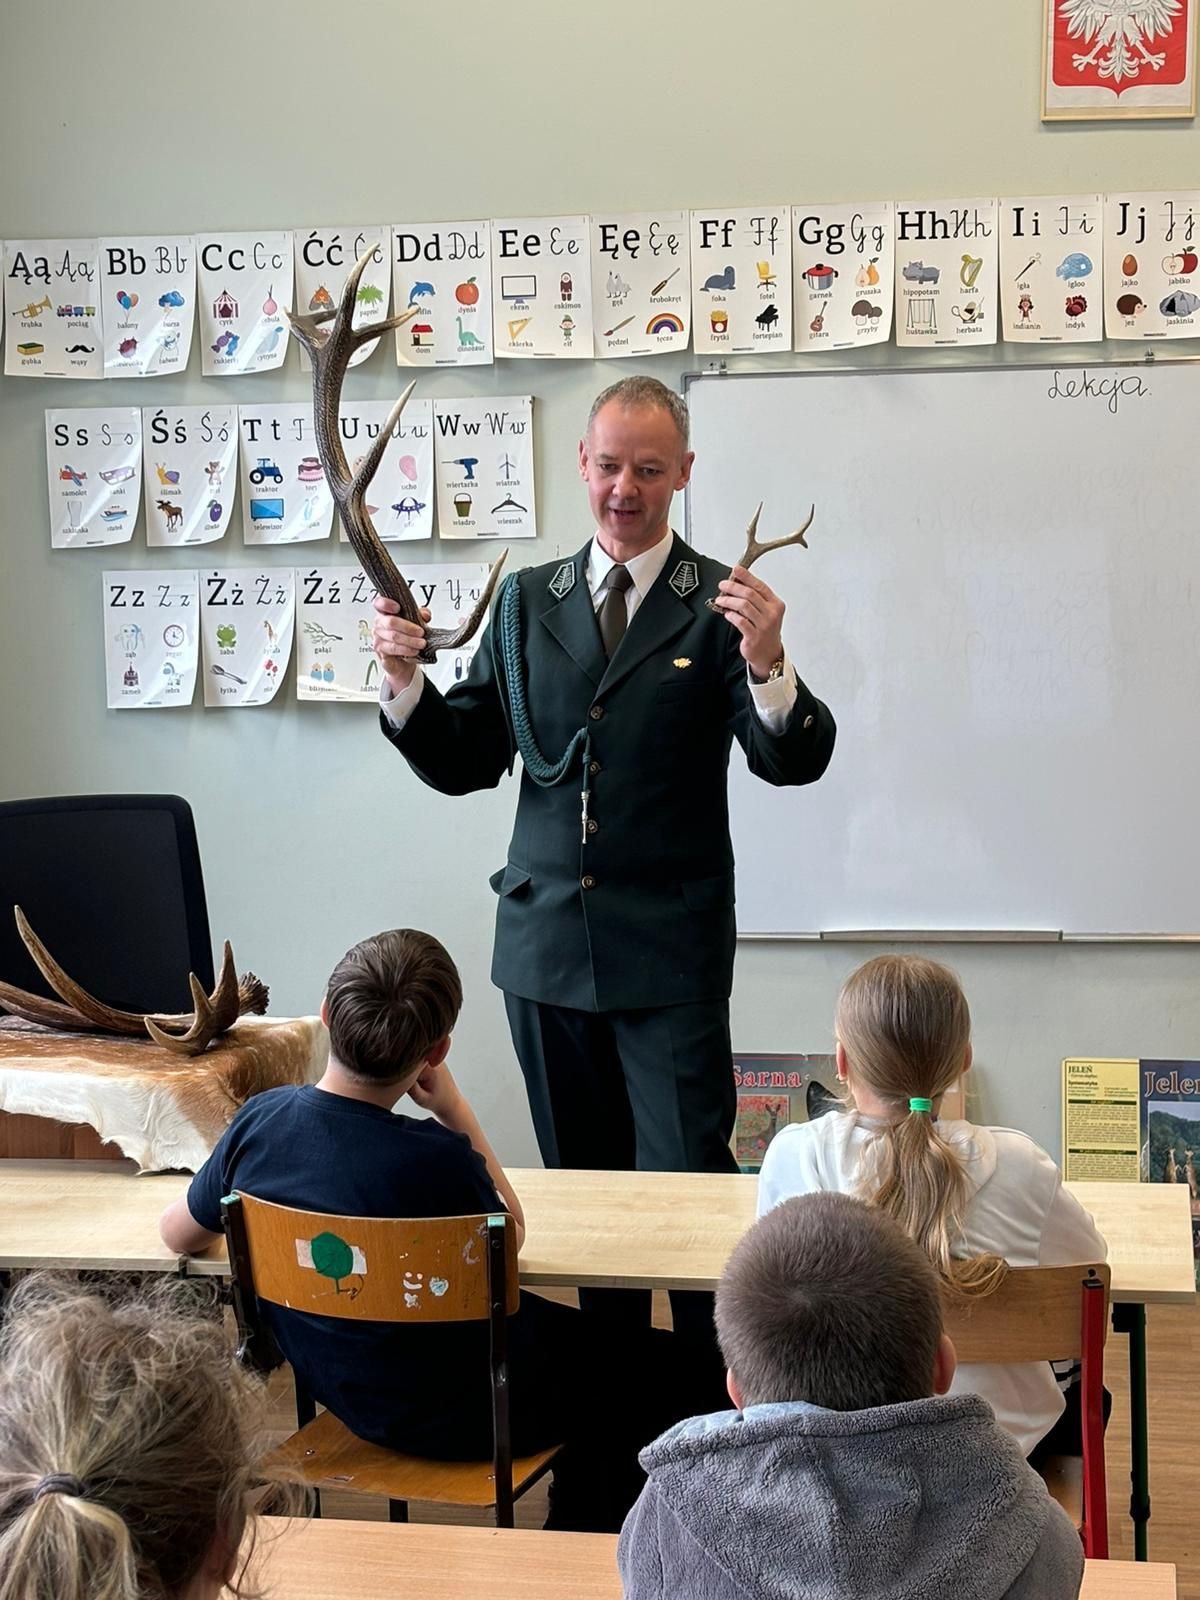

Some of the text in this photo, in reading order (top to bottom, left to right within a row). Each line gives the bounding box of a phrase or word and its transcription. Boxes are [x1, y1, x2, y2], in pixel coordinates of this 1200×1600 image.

[897, 210, 950, 241] Hh
[699, 216, 779, 256] Ff Ff
[798, 213, 885, 255] Gg Gg
[396, 231, 486, 262] Dd Dd
[498, 229, 541, 258] Ee
[598, 224, 641, 260] Ęę
[302, 230, 344, 267] Ćć
[106, 246, 188, 275] Bb Bb
[8, 251, 52, 286] Ąą
[1067, 280, 1086, 289] igloo
[1120, 279, 1139, 288] jajko
[1168, 278, 1191, 287] jabłko
[855, 288, 882, 298] gruszka
[903, 288, 940, 298] hipopotam
[959, 286, 979, 294] harfa
[711, 294, 727, 302] foka
[759, 292, 776, 300] fotel
[808, 292, 833, 301] garnek
[67, 321, 89, 330] pociąg
[1065, 321, 1086, 330] indyk
[1166, 318, 1195, 327] jaskinia
[905, 327, 938, 335] huśtawka
[956, 326, 983, 335] herbata
[752, 331, 784, 340] fortepian
[808, 331, 829, 340] gitara
[446, 480, 478, 488] wiertarka
[495, 479, 520, 487] wiatrak
